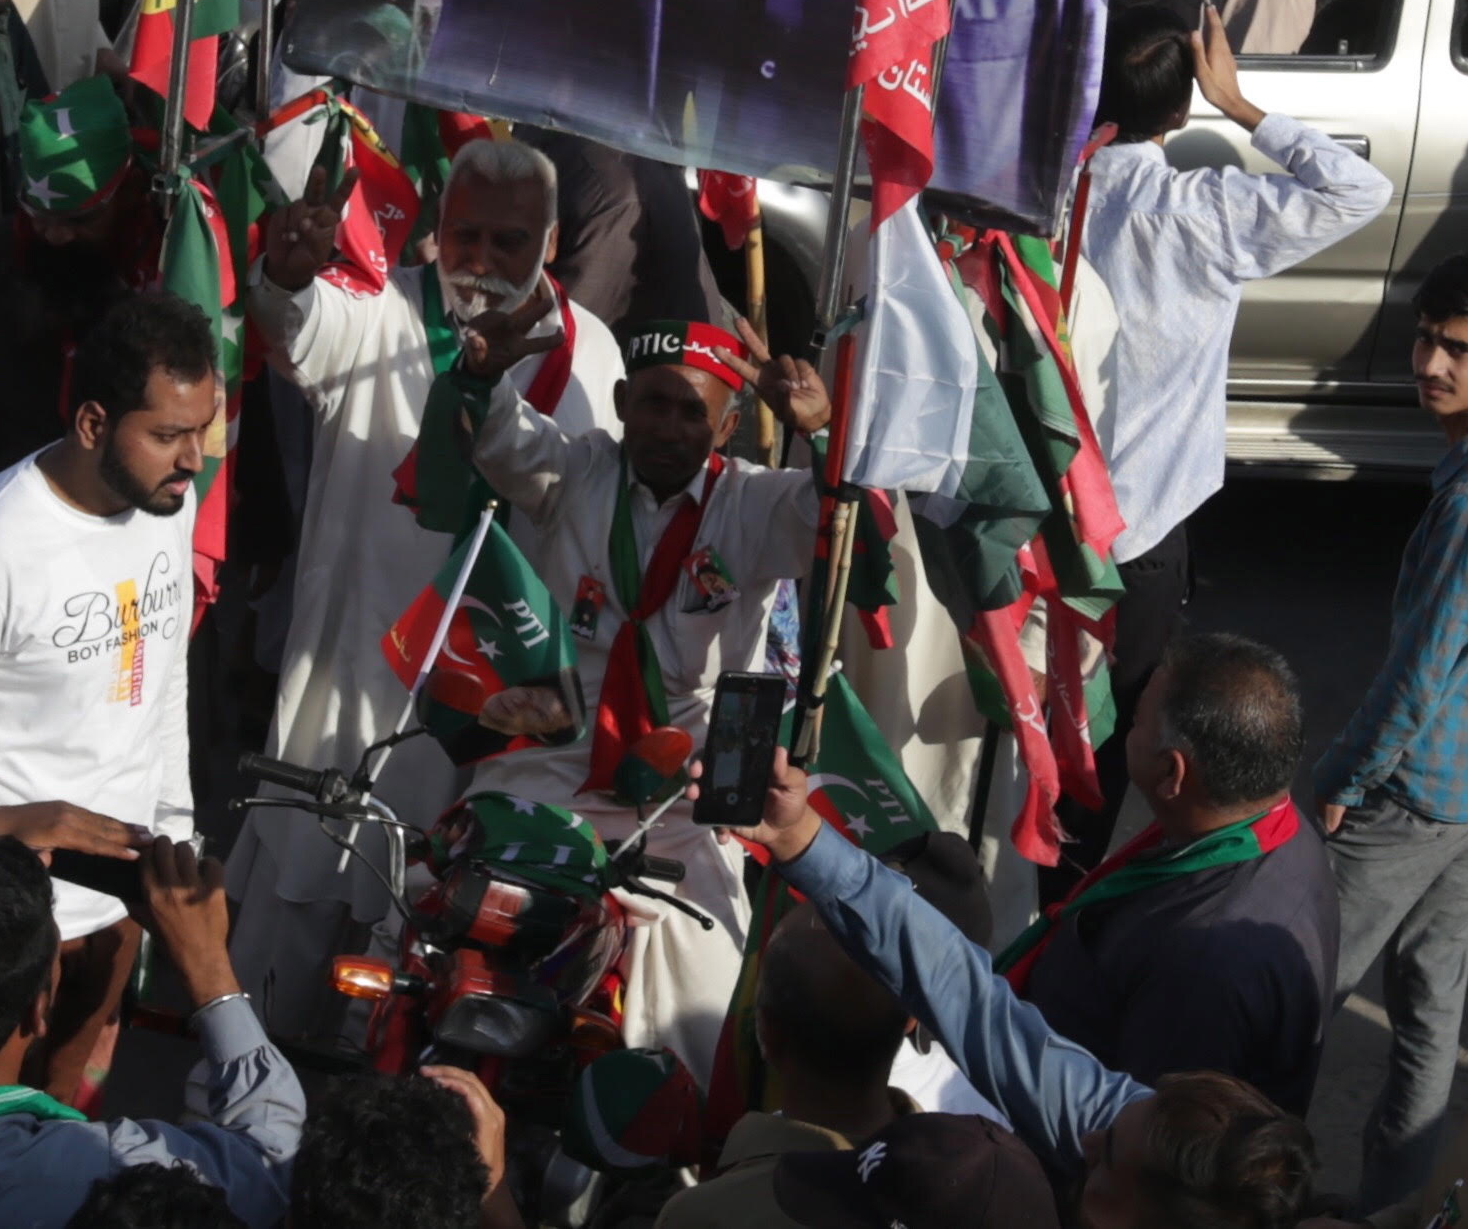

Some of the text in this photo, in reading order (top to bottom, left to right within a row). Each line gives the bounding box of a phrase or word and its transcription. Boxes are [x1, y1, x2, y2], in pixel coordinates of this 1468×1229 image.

[629, 332, 661, 359] PTI
[67, 620, 160, 664] BOY FASHION
[502, 597, 550, 651] PTI
[864, 777, 912, 825] PTI
